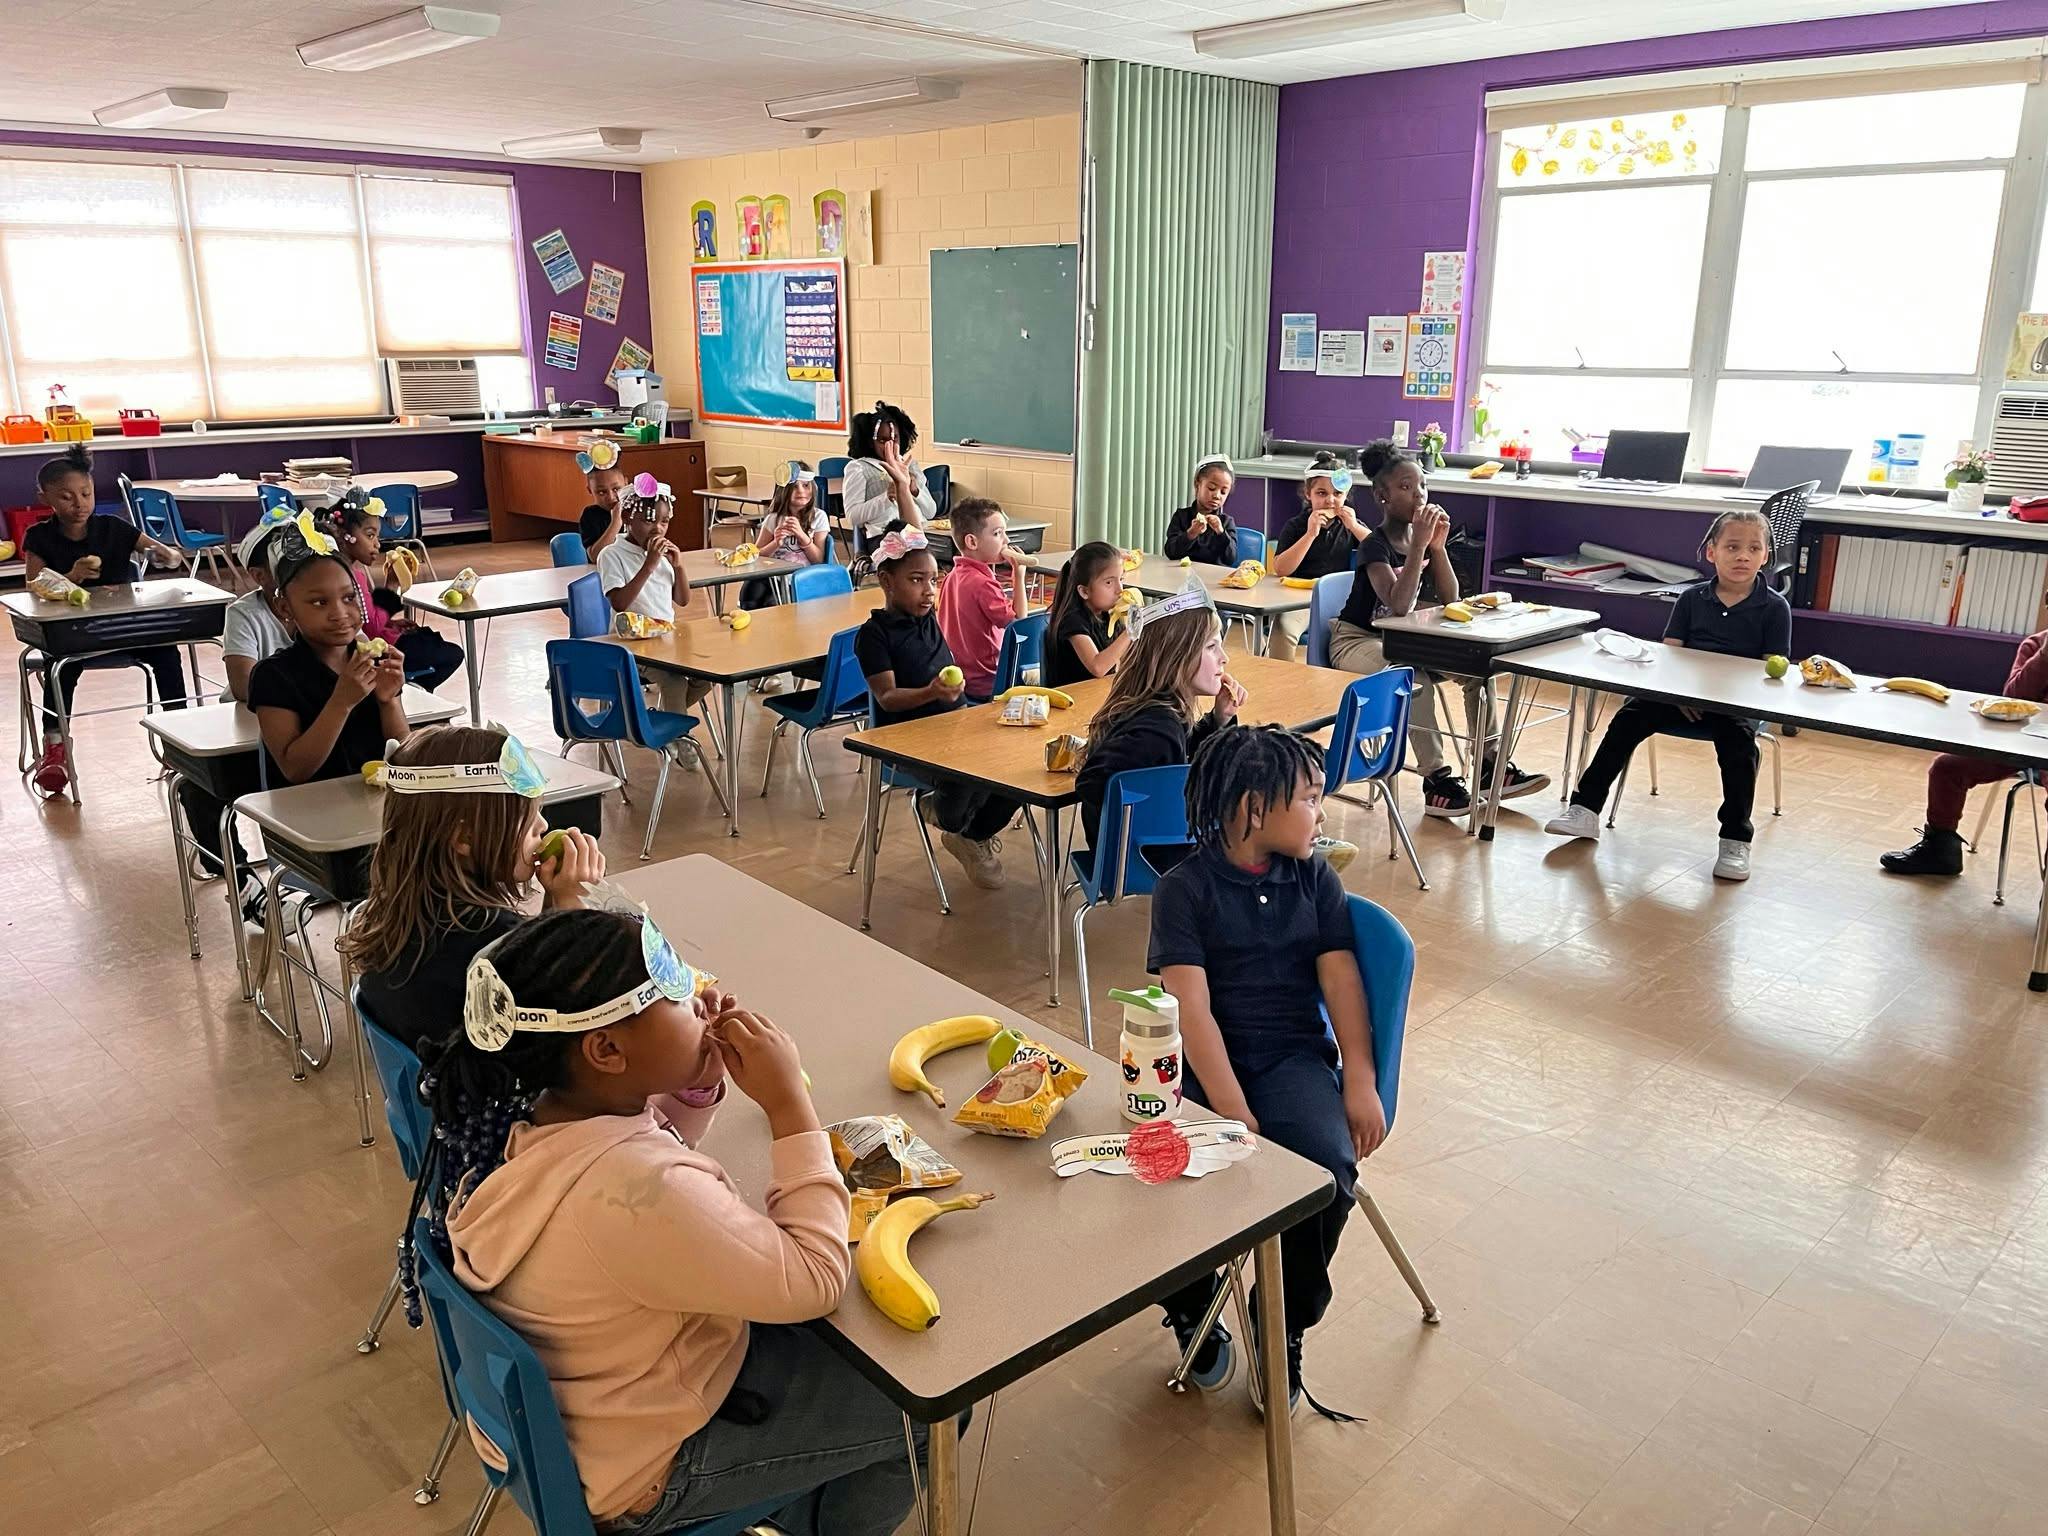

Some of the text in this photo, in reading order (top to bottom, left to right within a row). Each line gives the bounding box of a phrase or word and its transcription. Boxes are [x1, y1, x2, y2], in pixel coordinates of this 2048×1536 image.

[388, 769, 416, 781] Moon
[465, 765, 498, 776] Earth
[1129, 1094, 1165, 1115] 1up
[1090, 1145, 1125, 1157] Moon
